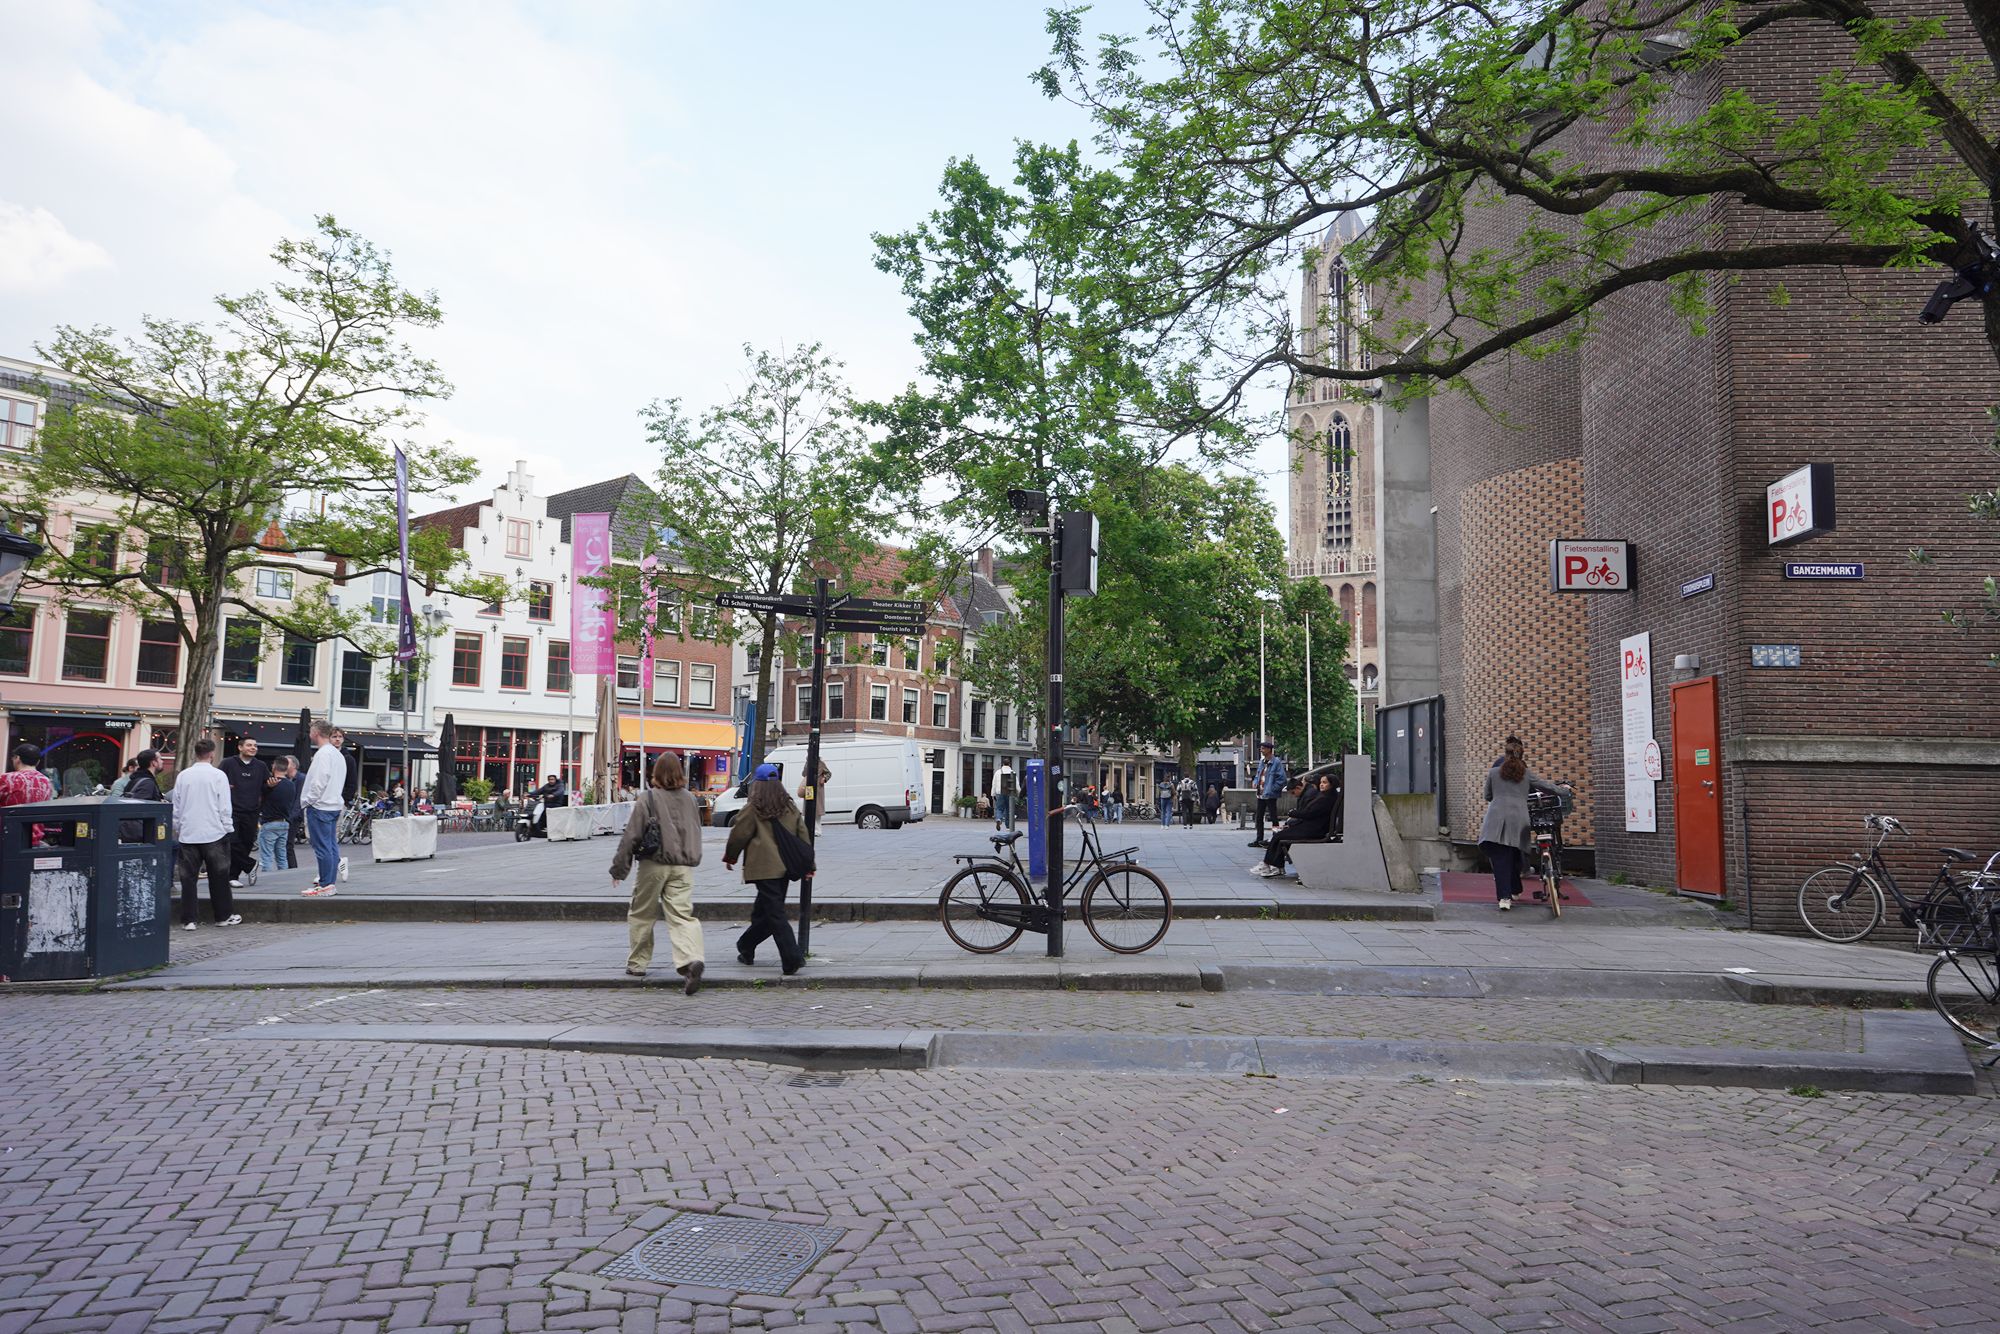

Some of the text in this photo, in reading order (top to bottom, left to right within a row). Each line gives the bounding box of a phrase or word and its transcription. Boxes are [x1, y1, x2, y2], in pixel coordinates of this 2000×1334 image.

[1772, 499, 1787, 538] P
[1564, 544, 1619, 554] Fietsenstalling
[1565, 556, 1589, 585] P
[1793, 566, 1857, 575] GANZENMARKT
[731, 600, 774, 610] Schiller Theater
[1625, 650, 1634, 680] P
[105, 720, 132, 728] daen's
